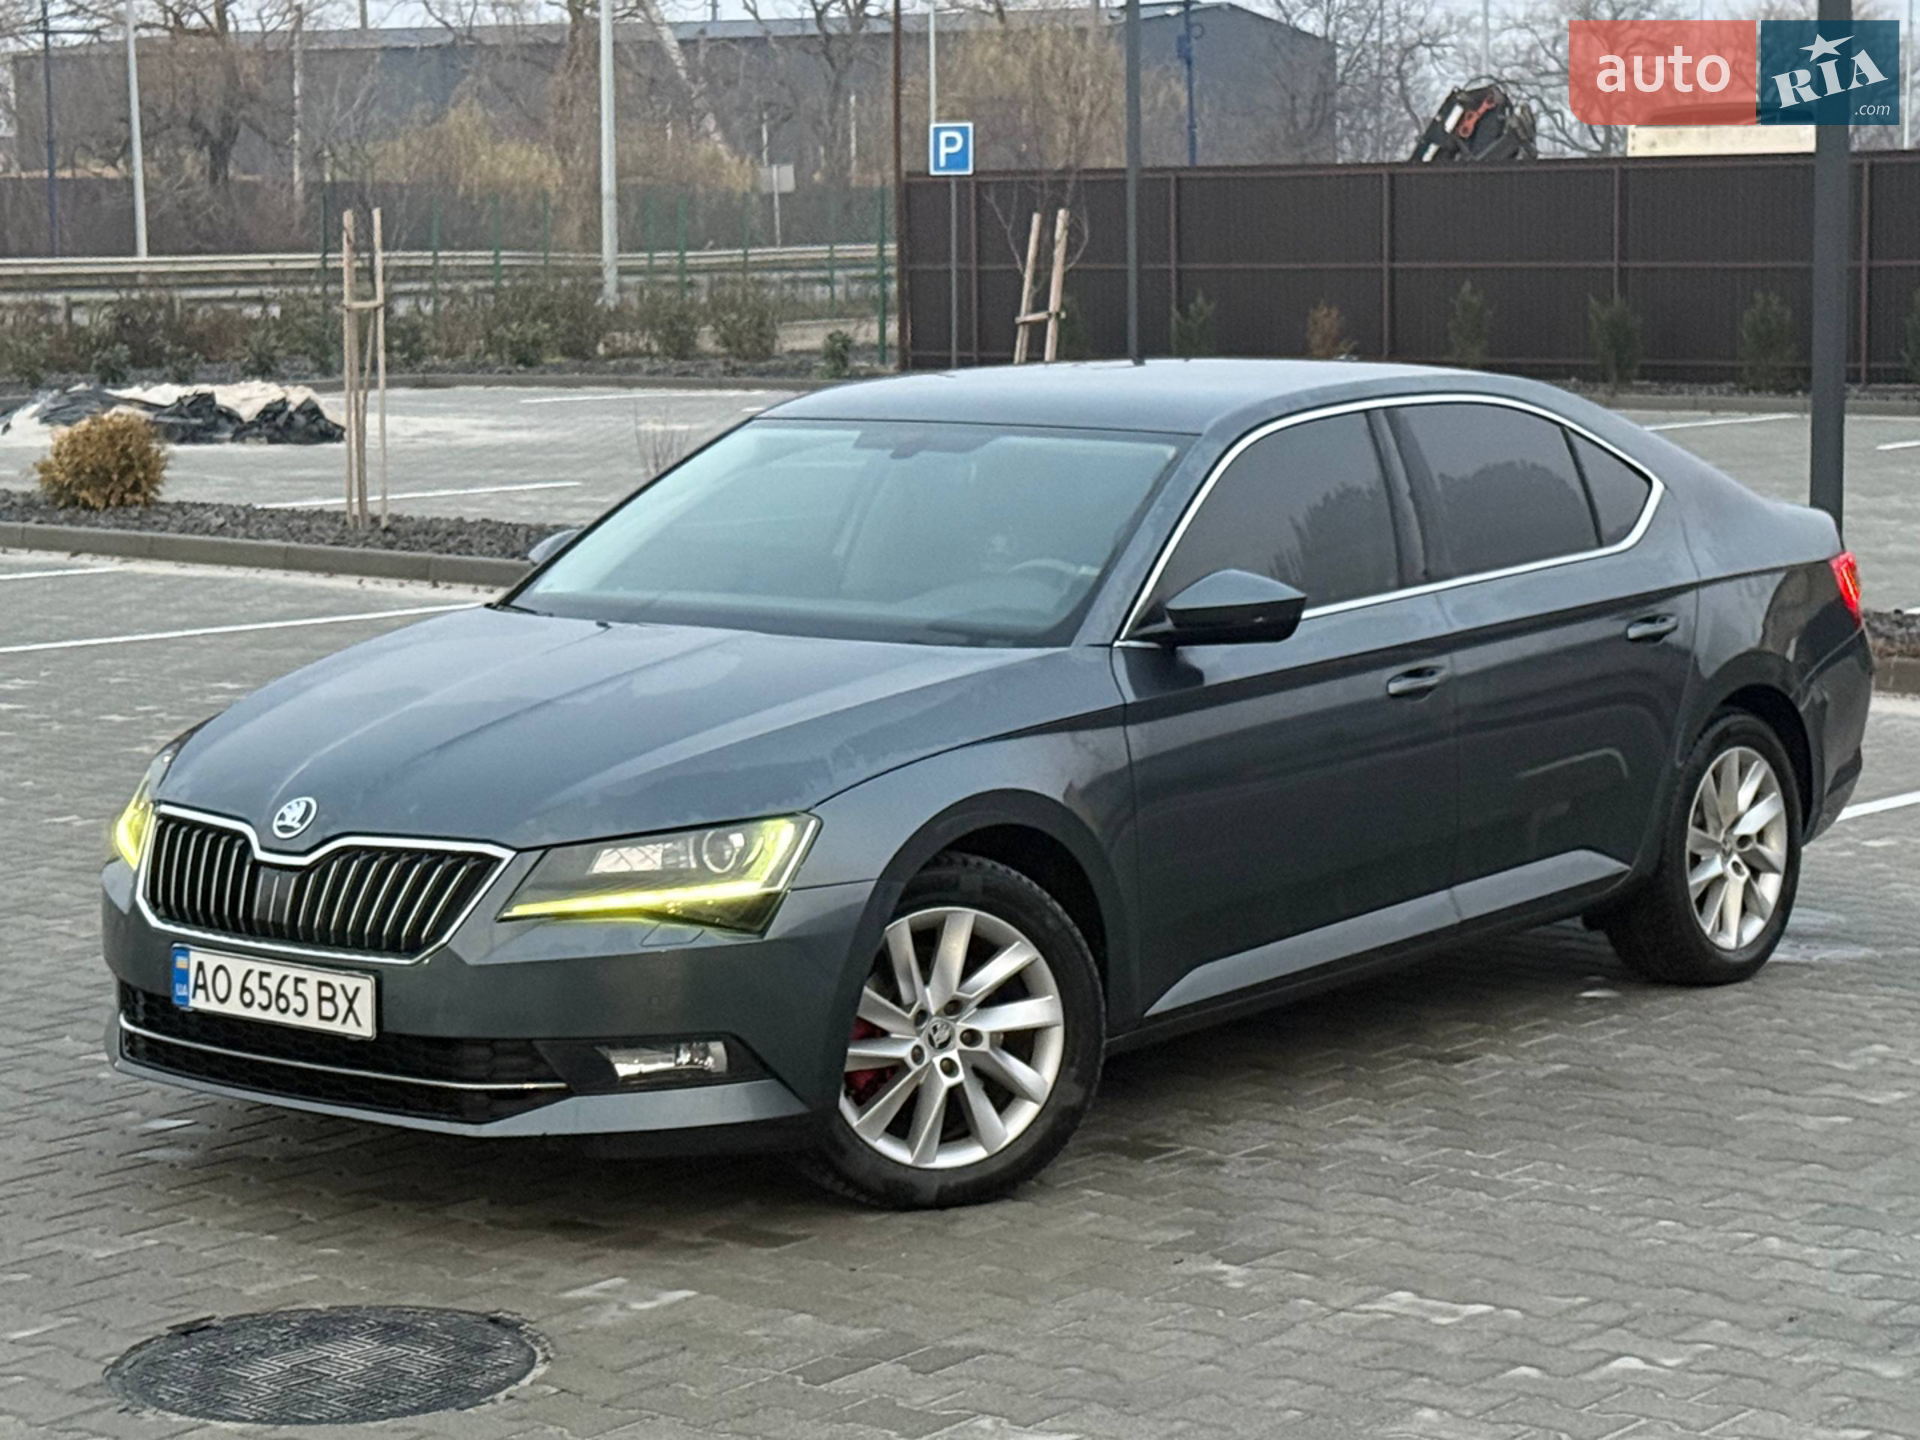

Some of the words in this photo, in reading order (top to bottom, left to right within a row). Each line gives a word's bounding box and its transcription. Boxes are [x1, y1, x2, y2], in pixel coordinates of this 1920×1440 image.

[939, 131, 964, 168] P
[175, 983, 189, 996] UA
[191, 960, 233, 1005] AO
[239, 968, 309, 1018] 6565
[317, 980, 363, 1028] BX
